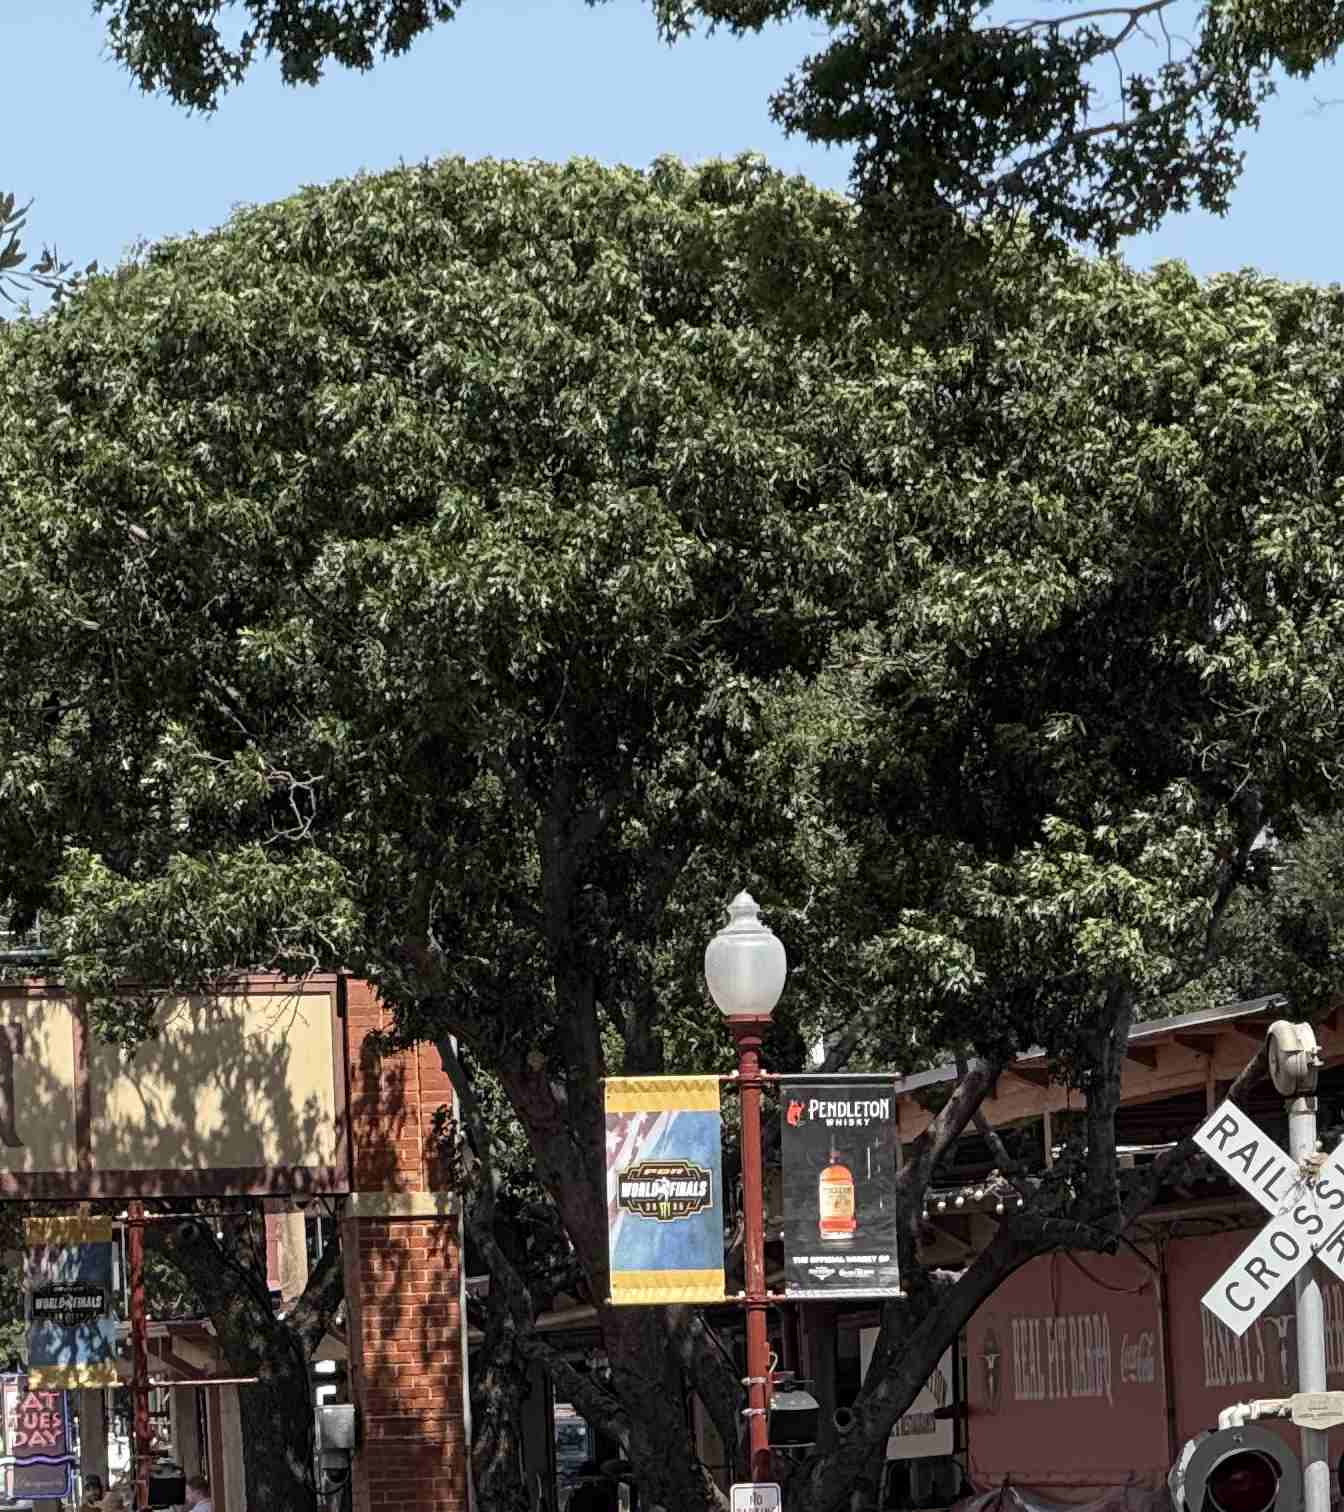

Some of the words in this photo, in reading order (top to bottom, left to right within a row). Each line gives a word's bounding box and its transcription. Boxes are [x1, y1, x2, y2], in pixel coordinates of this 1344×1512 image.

[808, 1099, 889, 1120] PENDLETON
[825, 1118, 870, 1127] WHISKY
[1206, 1113, 1286, 1202] RAIL
[621, 1181, 657, 1199] WORLD
[670, 1180, 708, 1197] FINALS
[35, 1297, 64, 1310] WORLD
[73, 1295, 102, 1309] FINALS
[1011, 1319, 1045, 1400] REAL
[1045, 1316, 1068, 1399] PIT
[18, 1391, 60, 1411] AT
[13, 1430, 64, 1448] DAY
[750, 1493, 763, 1505] NO
